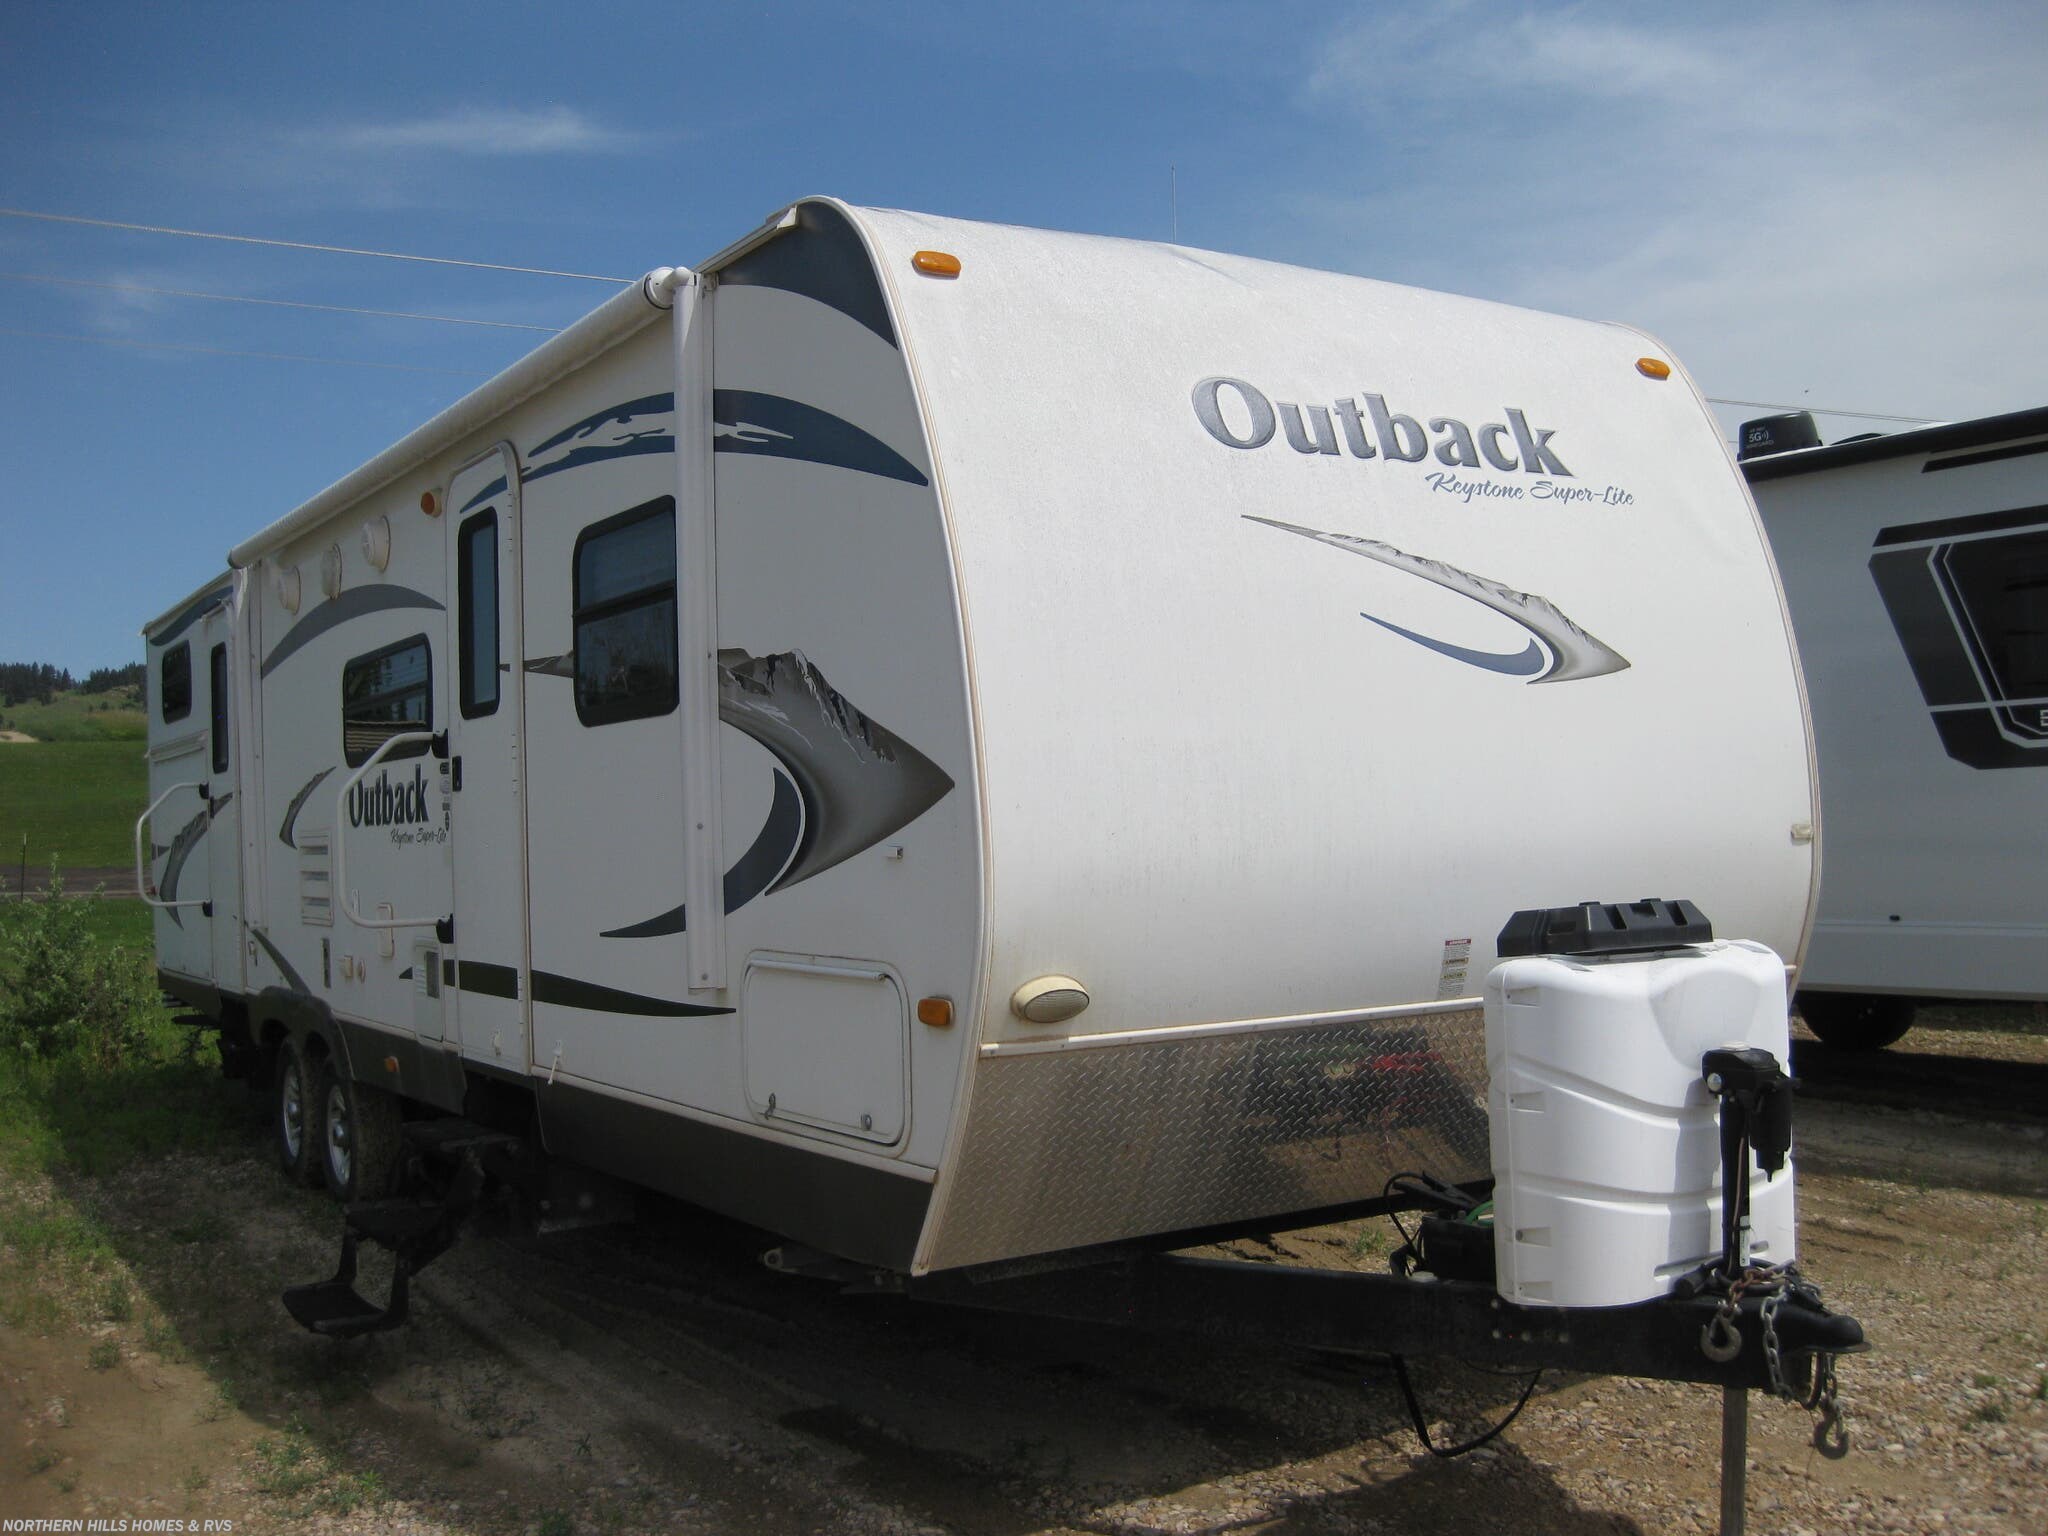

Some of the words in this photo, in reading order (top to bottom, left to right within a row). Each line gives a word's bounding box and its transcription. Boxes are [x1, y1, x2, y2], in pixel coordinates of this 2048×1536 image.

[1191, 376, 1574, 477] Outback
[1425, 472, 1525, 503] Keystone
[1530, 480, 1634, 506] Super-Lite
[349, 763, 429, 828] Outback
